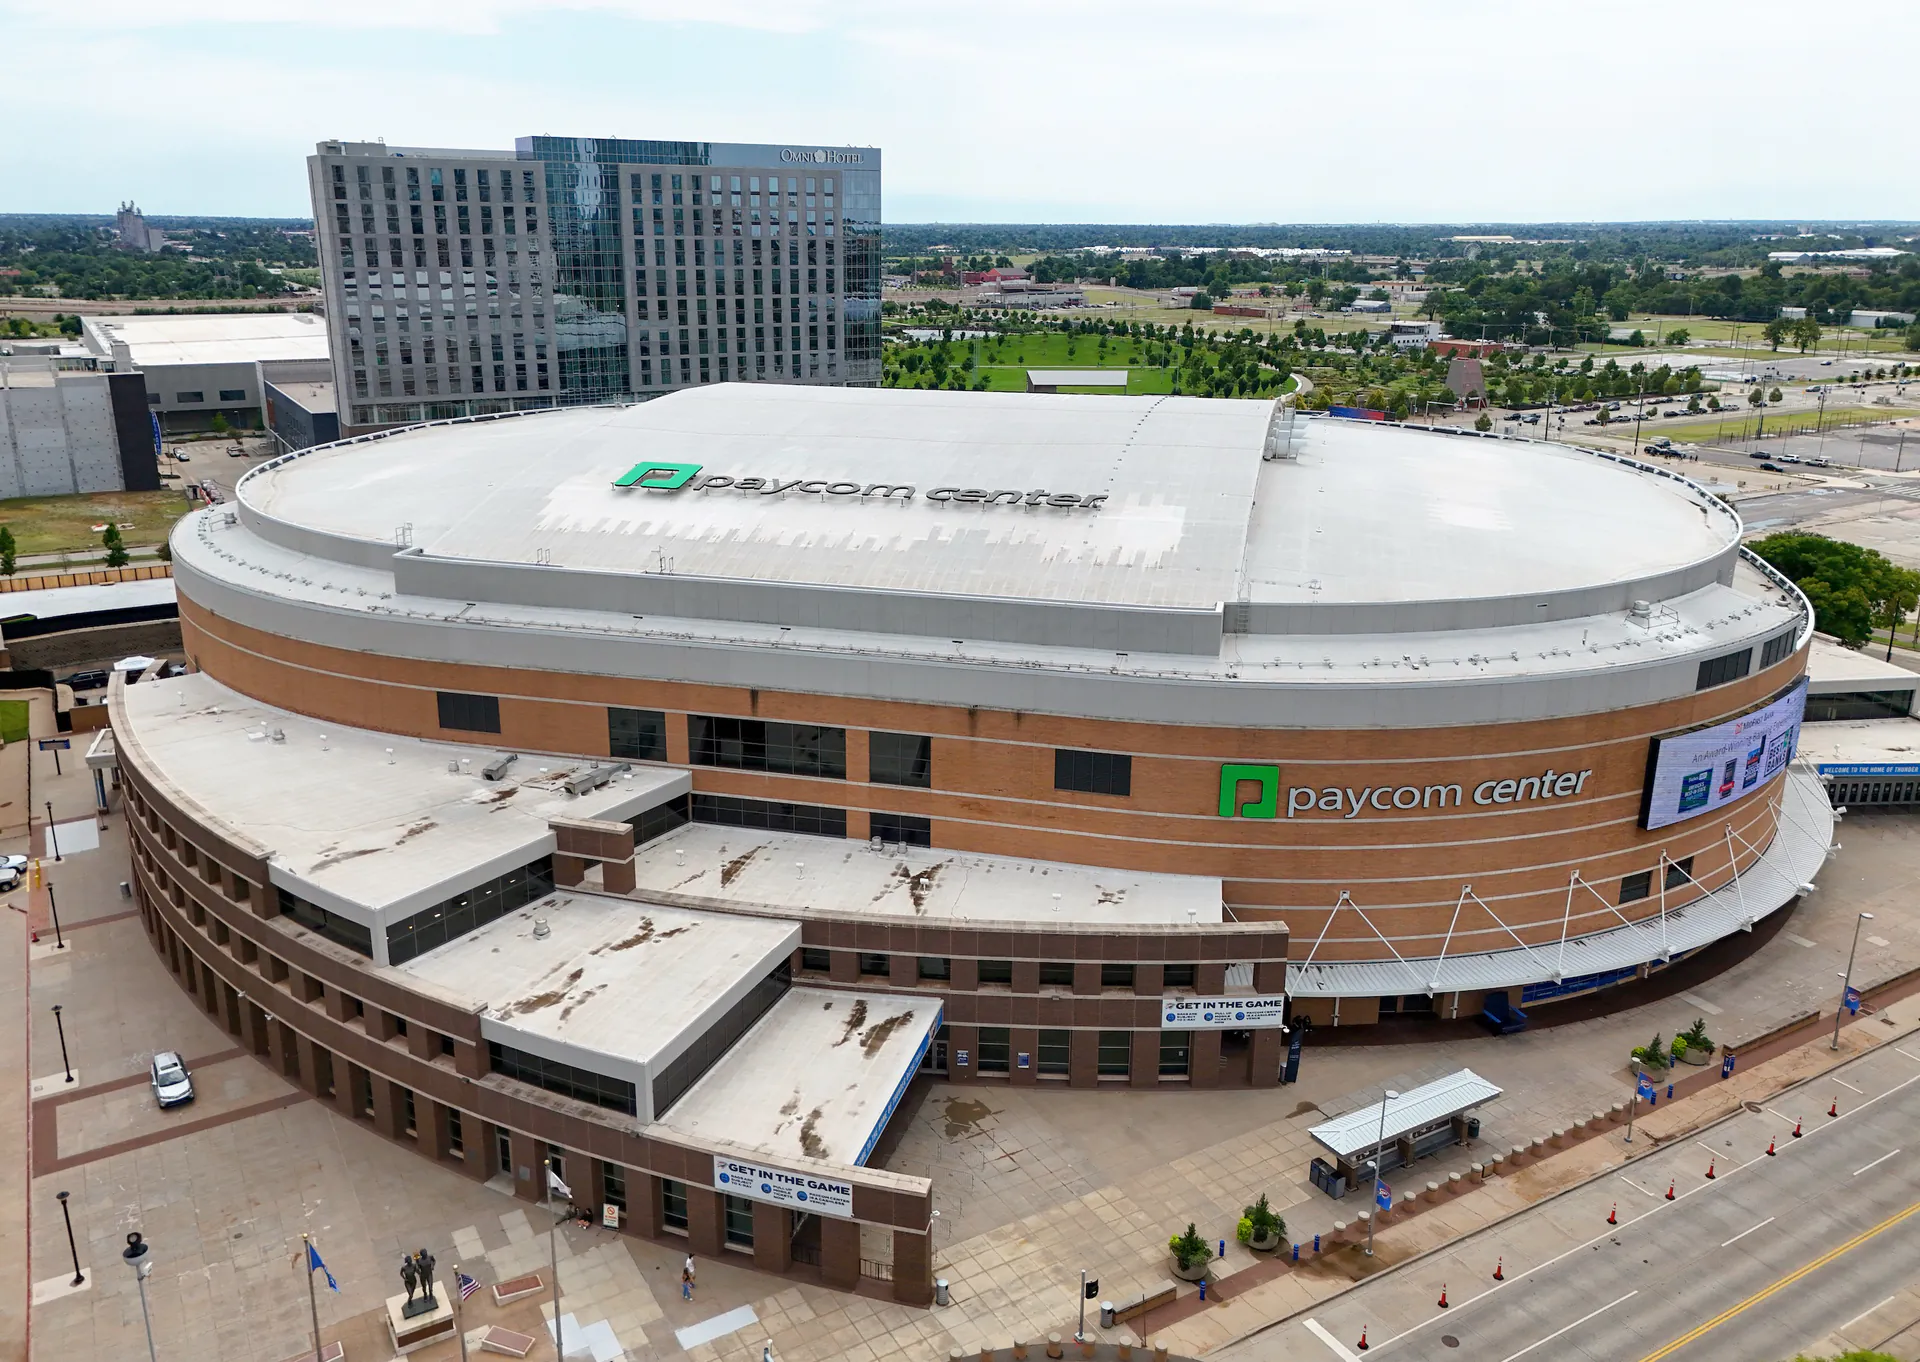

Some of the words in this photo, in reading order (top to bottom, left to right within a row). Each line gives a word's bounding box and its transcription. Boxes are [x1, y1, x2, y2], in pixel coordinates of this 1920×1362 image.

[693, 472, 917, 500] paycom
[926, 486, 1109, 508] center
[1769, 742, 1784, 760] BEST
[1287, 783, 1463, 819] paycom
[1472, 768, 1593, 805] center
[1175, 1002, 1201, 1010] GET
[1218, 1001, 1244, 1009] THE
[1245, 1000, 1282, 1008] GAME
[728, 1163, 756, 1175] GET
[758, 1170, 773, 1181] IN
[775, 1174, 805, 1187] THE
[807, 1180, 851, 1196] GAME
